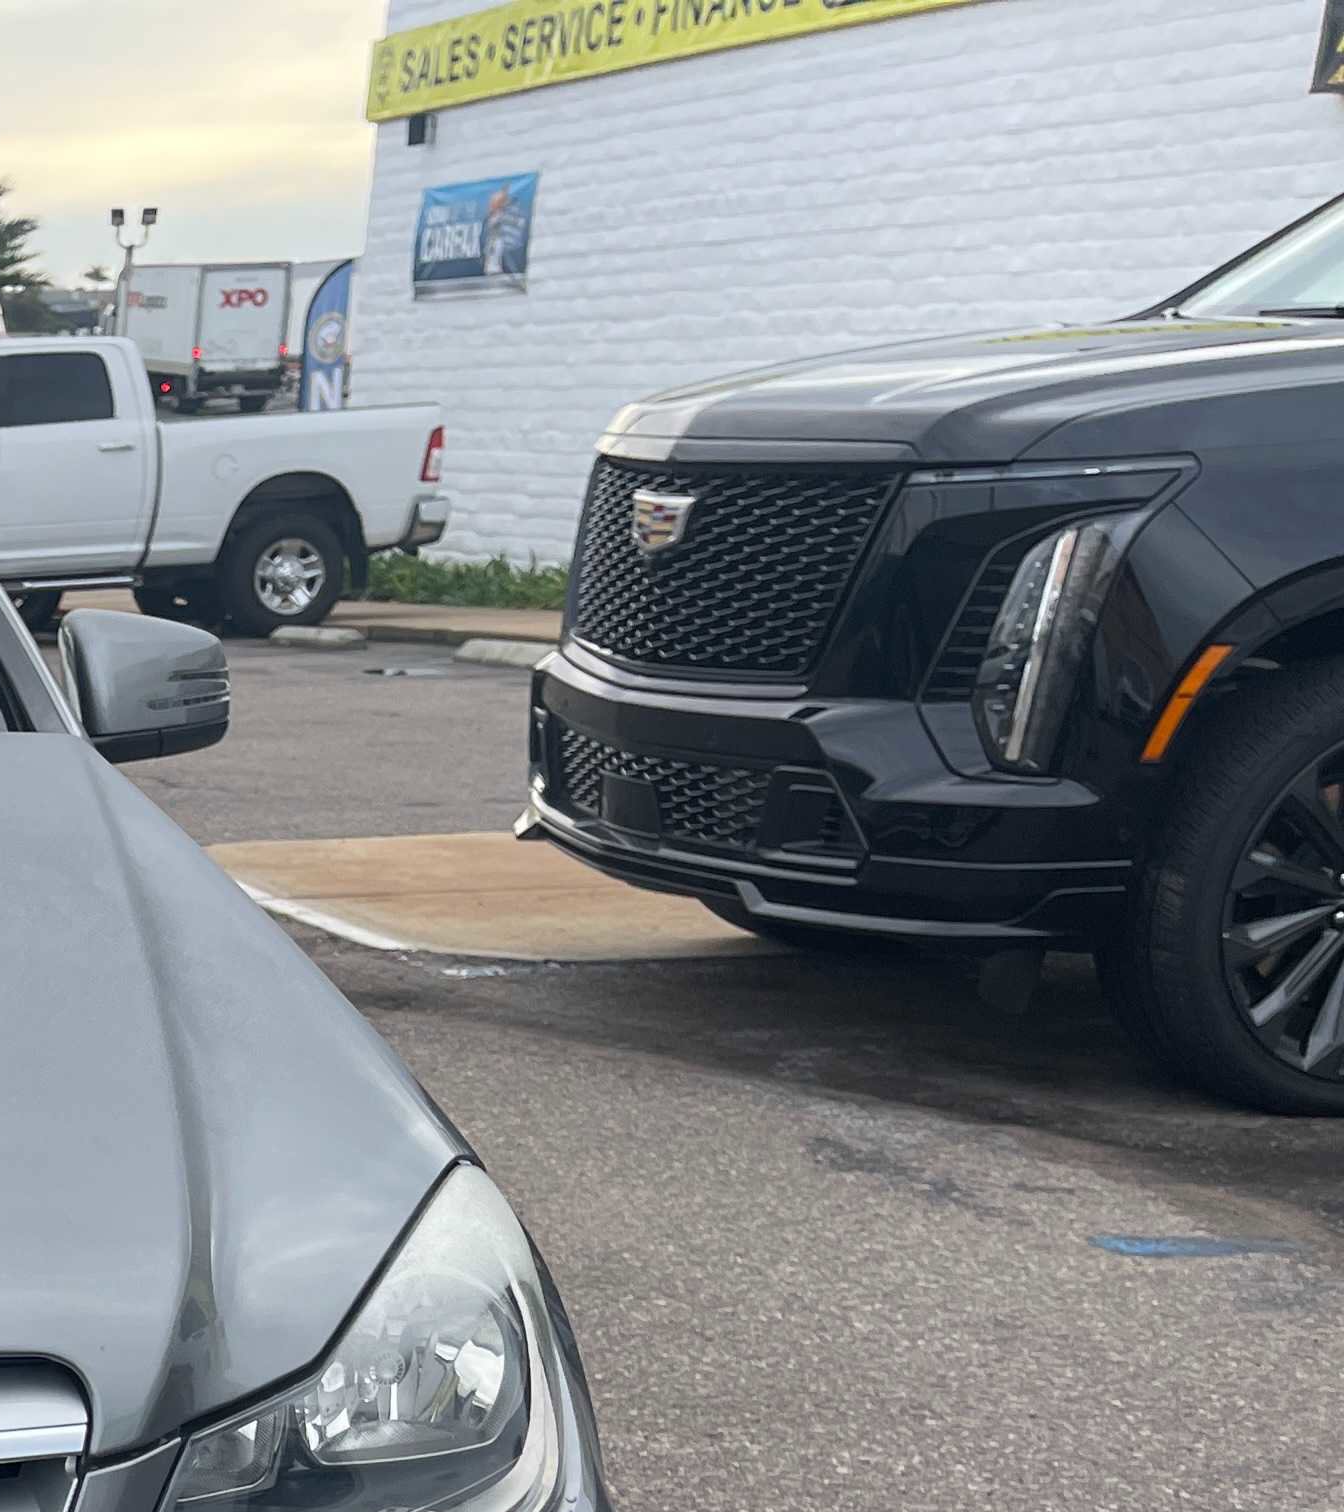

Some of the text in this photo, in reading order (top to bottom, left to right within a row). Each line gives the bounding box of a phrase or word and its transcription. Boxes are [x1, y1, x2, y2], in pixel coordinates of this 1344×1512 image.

[400, 0, 801, 93] SALES SERVICE FINA
[219, 288, 269, 309] XPO
